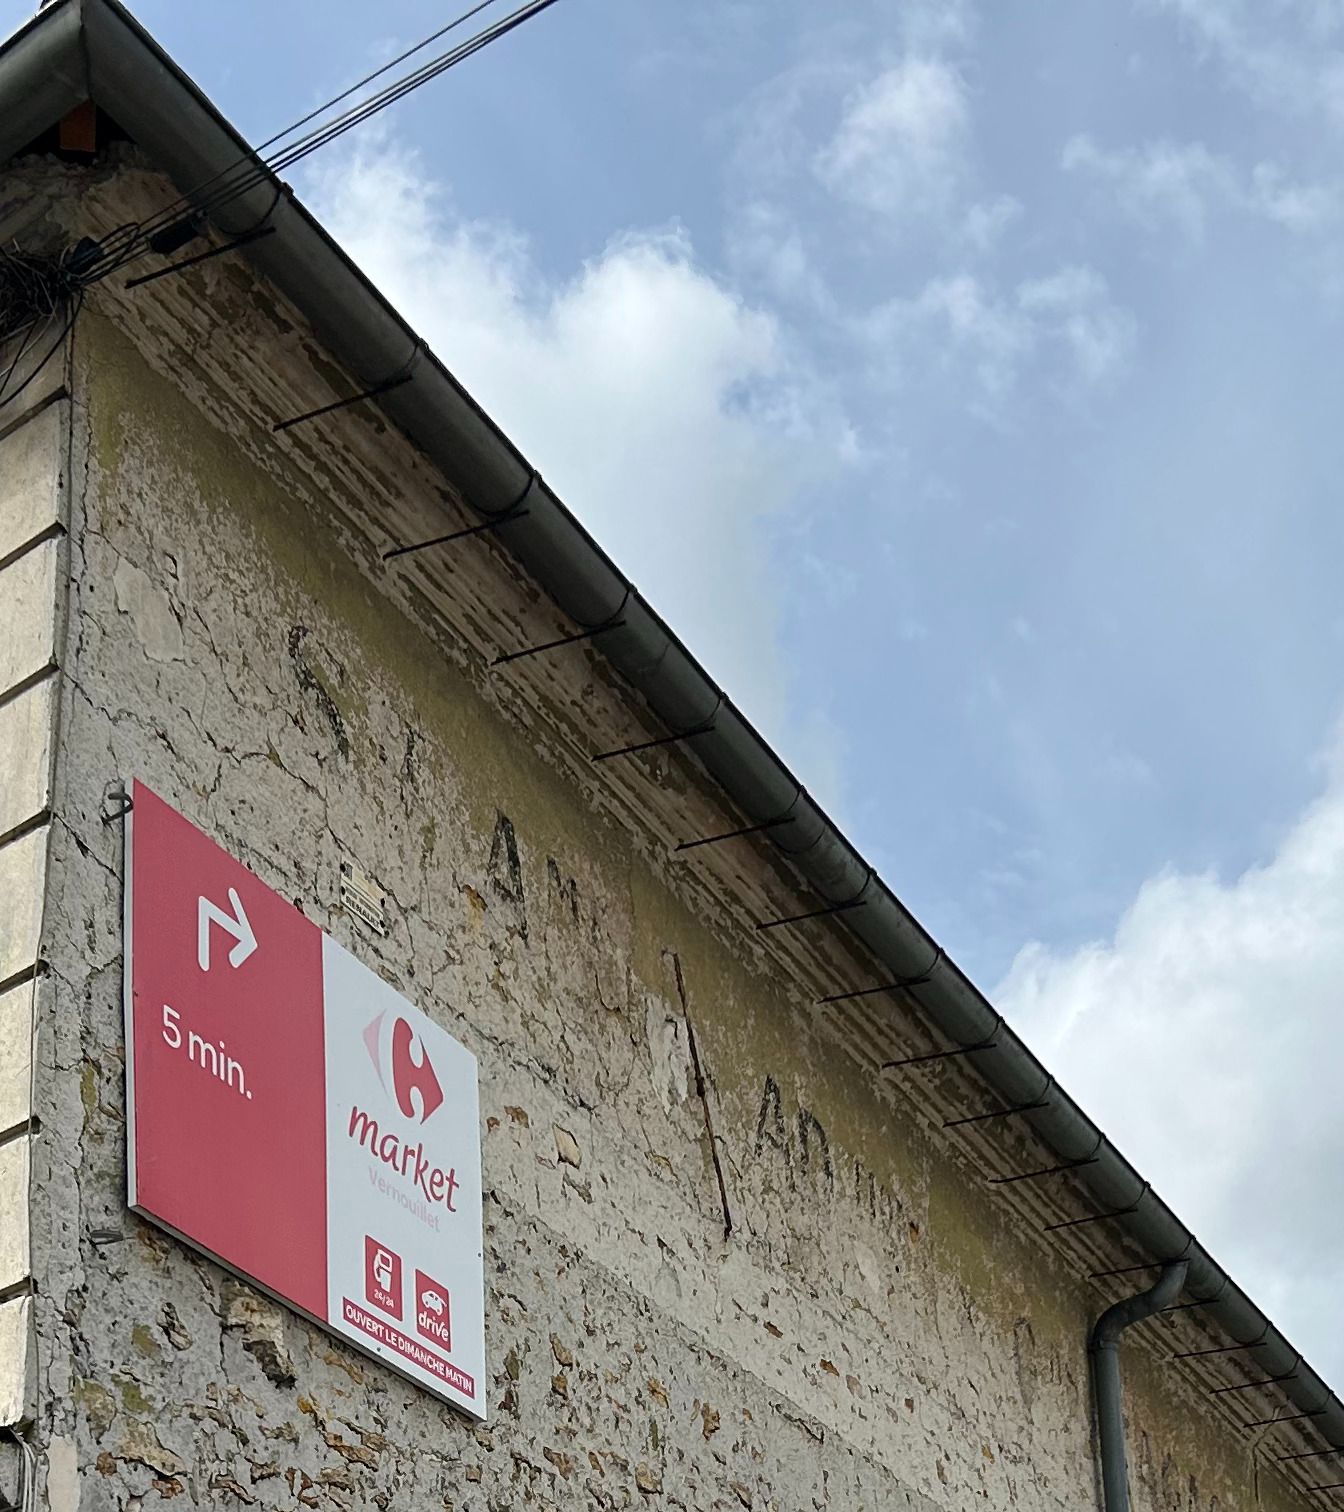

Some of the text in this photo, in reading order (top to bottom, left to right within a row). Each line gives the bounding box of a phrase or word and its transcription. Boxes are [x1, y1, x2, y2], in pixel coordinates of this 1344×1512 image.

[162, 1004, 252, 1100] 5 min.
[349, 1105, 459, 1212] market
[368, 1165, 440, 1232] Vernouillet
[346, 1304, 473, 1394] OUVERT LE DIMANCHE MATIN
[418, 1310, 449, 1341] drive
